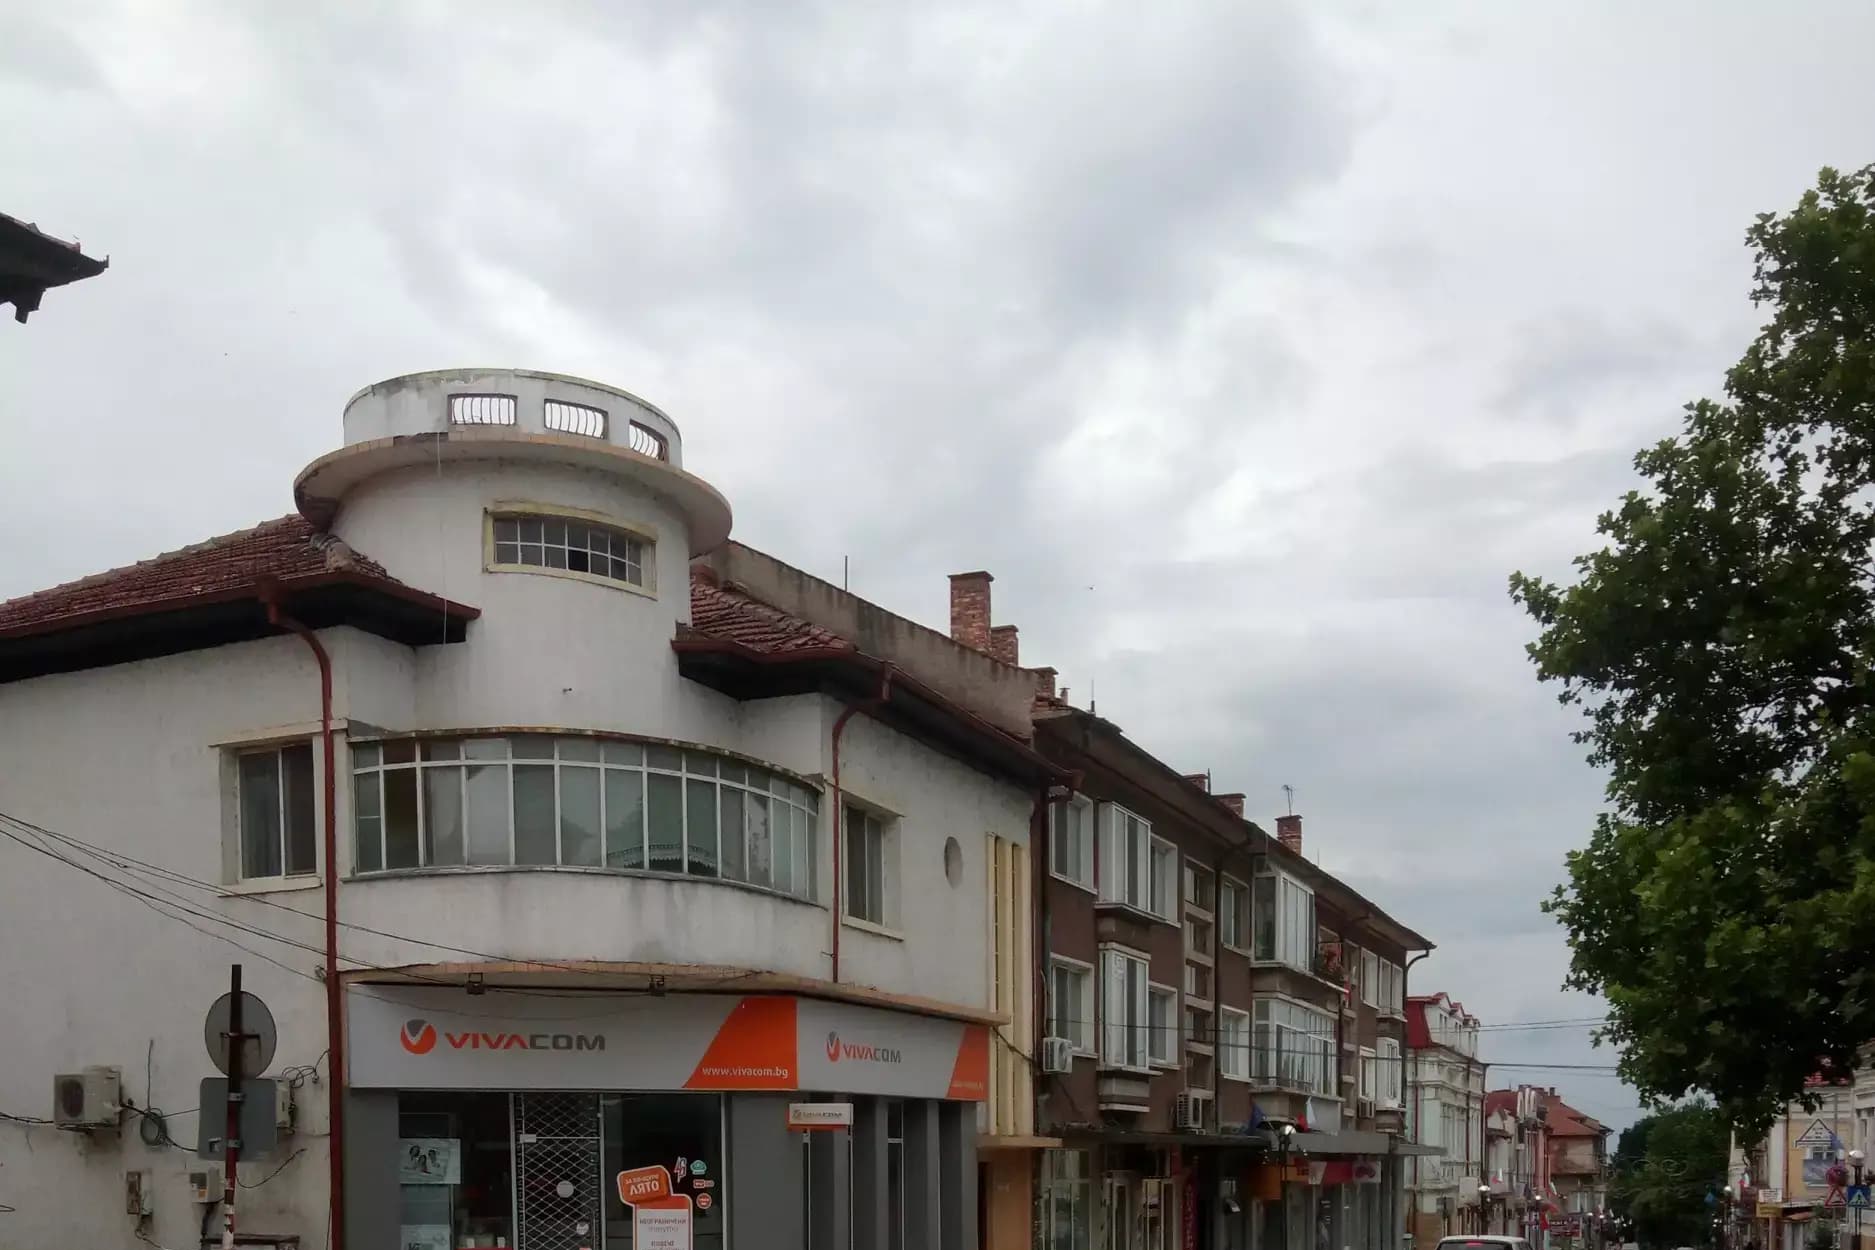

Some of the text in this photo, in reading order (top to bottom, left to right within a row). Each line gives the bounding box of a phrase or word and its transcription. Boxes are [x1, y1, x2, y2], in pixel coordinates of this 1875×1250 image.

[444, 1032, 606, 1051] VIVACOM
[843, 1043, 901, 1063] VIVACOM
[702, 1066, 789, 1079] www.vivacom.bg
[630, 1180, 660, 1196] ЛЯТО
